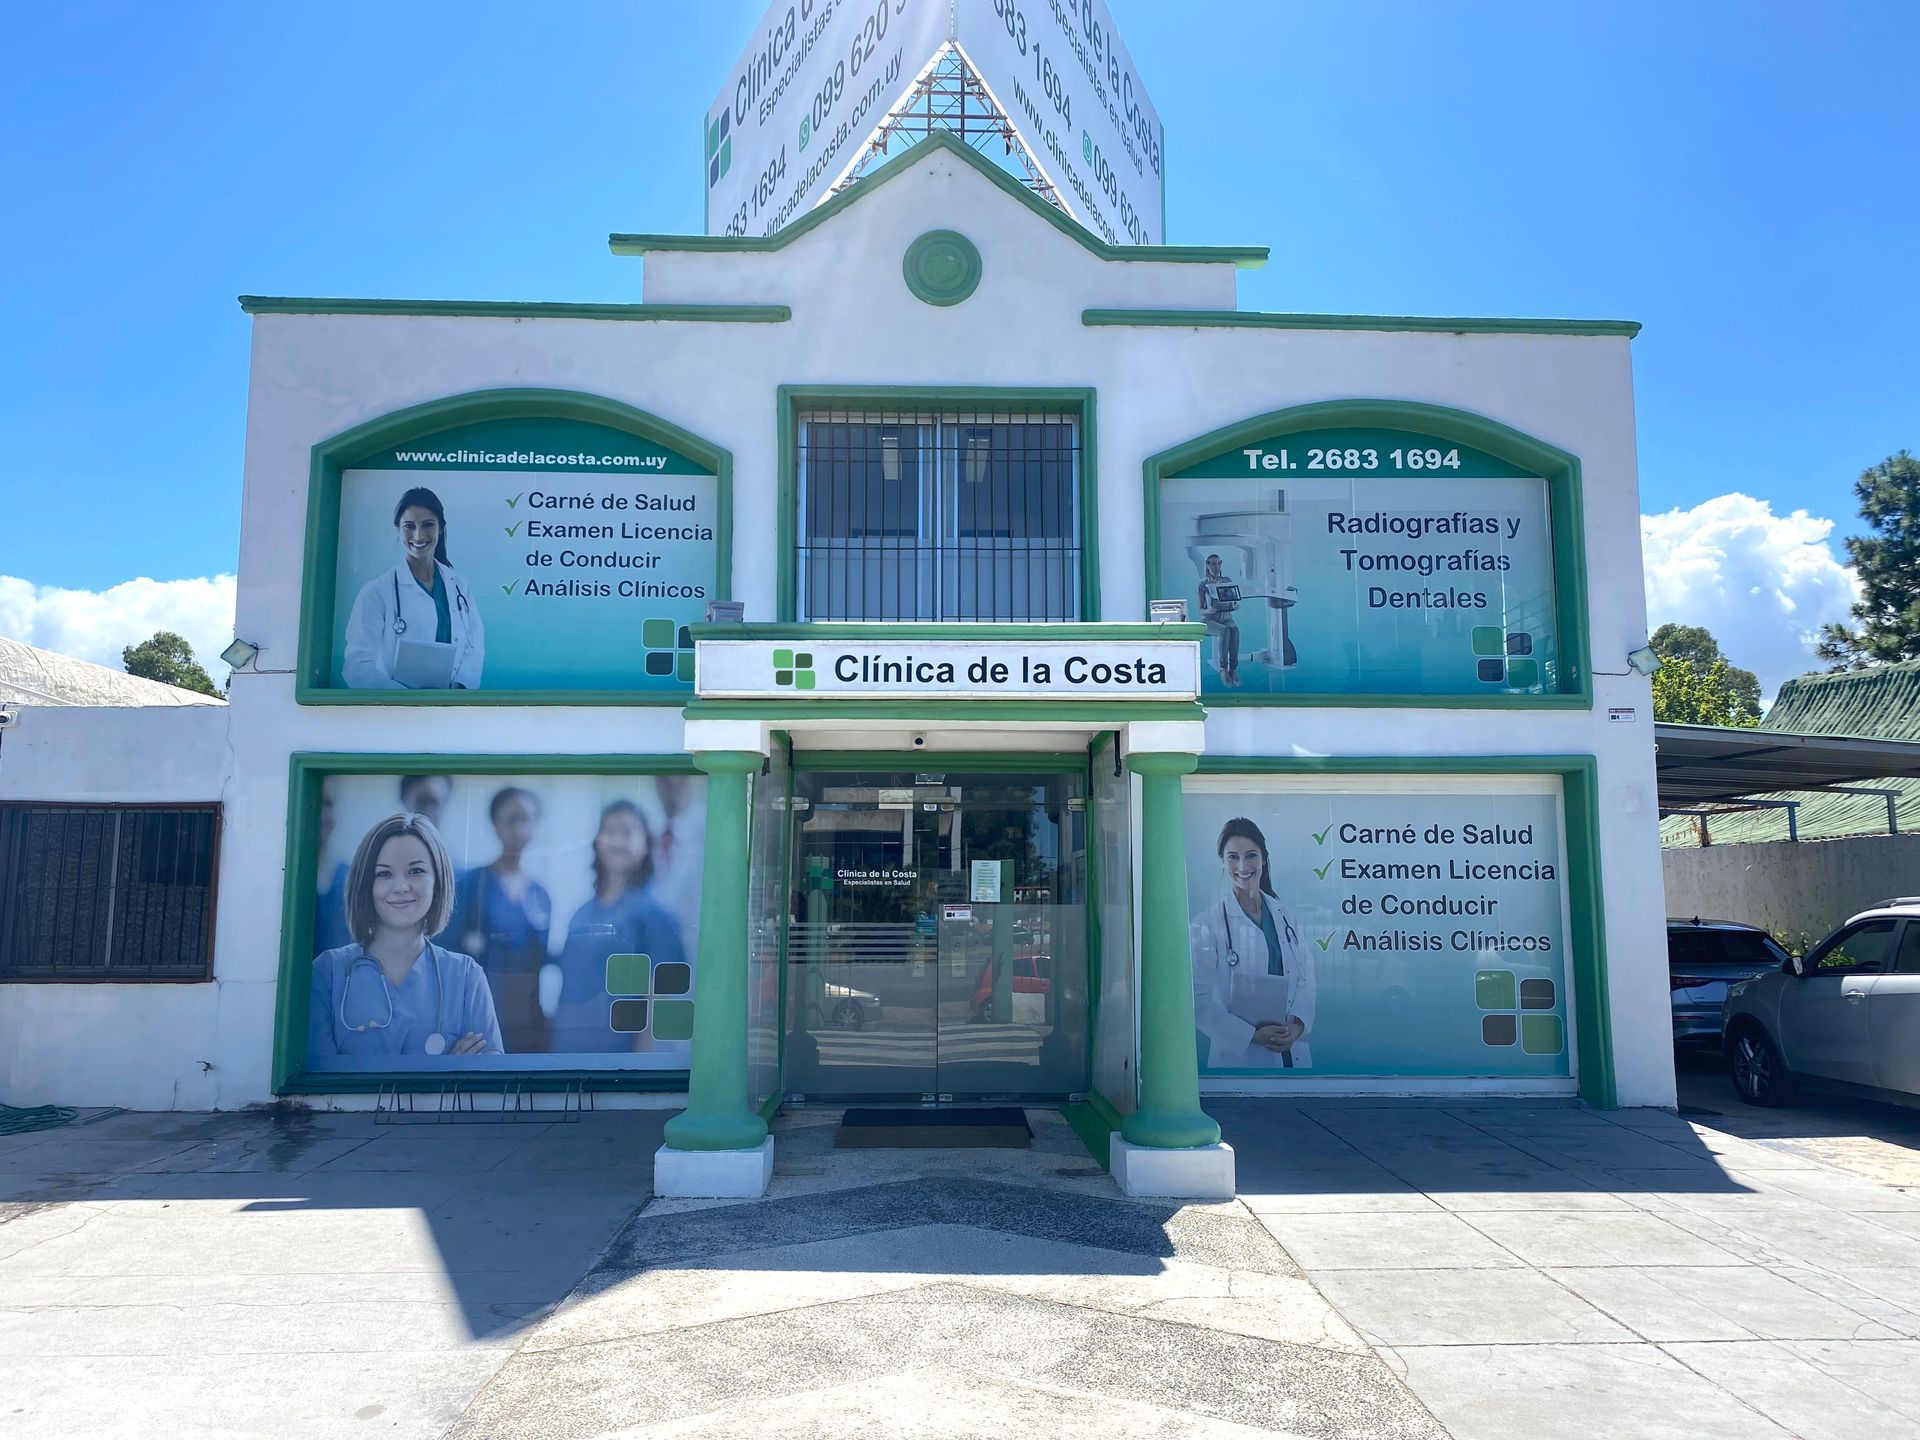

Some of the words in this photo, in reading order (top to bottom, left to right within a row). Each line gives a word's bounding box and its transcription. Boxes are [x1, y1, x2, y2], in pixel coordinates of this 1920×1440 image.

[735, 6, 796, 126] Clínica
[759, 1, 832, 127] Especialistas
[812, 59, 845, 132] 099
[851, 0, 889, 77] 620
[1032, 42, 1072, 132] 1694
[1082, 0, 1103, 63] de
[1107, 32, 1120, 100] la
[1124, 71, 1160, 180] Costa
[762, 47, 903, 238] linicadelacosta.com.uy
[1109, 103, 1120, 131] en
[1121, 120, 1143, 178] Salud
[751, 144, 787, 218] 1694
[1094, 145, 1117, 208] 099
[1120, 191, 1141, 246] 620
[395, 449, 667, 469] www.clinicadelacosta.com.uy
[1243, 449, 1297, 470] Tel.
[1307, 449, 1379, 470] 2683
[1389, 449, 1461, 470] 1694
[528, 490, 595, 510] Carné
[601, 492, 628, 510] de
[634, 493, 696, 512] Salud
[527, 521, 614, 539] Examen
[621, 522, 713, 541] Licencia
[1327, 511, 1499, 539] Radiografías
[1506, 517, 1521, 539] y
[525, 550, 552, 567] de
[559, 551, 661, 569] Conducir
[1339, 549, 1511, 576] Tomografías
[524, 578, 611, 597] Análisis
[618, 580, 705, 599] Clínicos
[1368, 586, 1488, 609] Dentales
[834, 654, 955, 684] Clínica
[967, 656, 1009, 684] de
[1022, 656, 1052, 684] la
[1063, 656, 1167, 685] Costa
[1338, 823, 1416, 845] Carné
[1423, 823, 1454, 845] de
[1462, 824, 1533, 845] Salud
[837, 869, 867, 878] Clínica
[869, 870, 880, 878] de
[882, 870, 890, 878] la
[892, 870, 917, 878] Costa
[1341, 859, 1440, 880] Examen
[1449, 859, 1555, 880] Licencia
[1341, 895, 1372, 915] de
[1380, 895, 1498, 916] Conducir
[1342, 929, 1443, 951] Análisis
[1449, 930, 1552, 952] Clínicos
